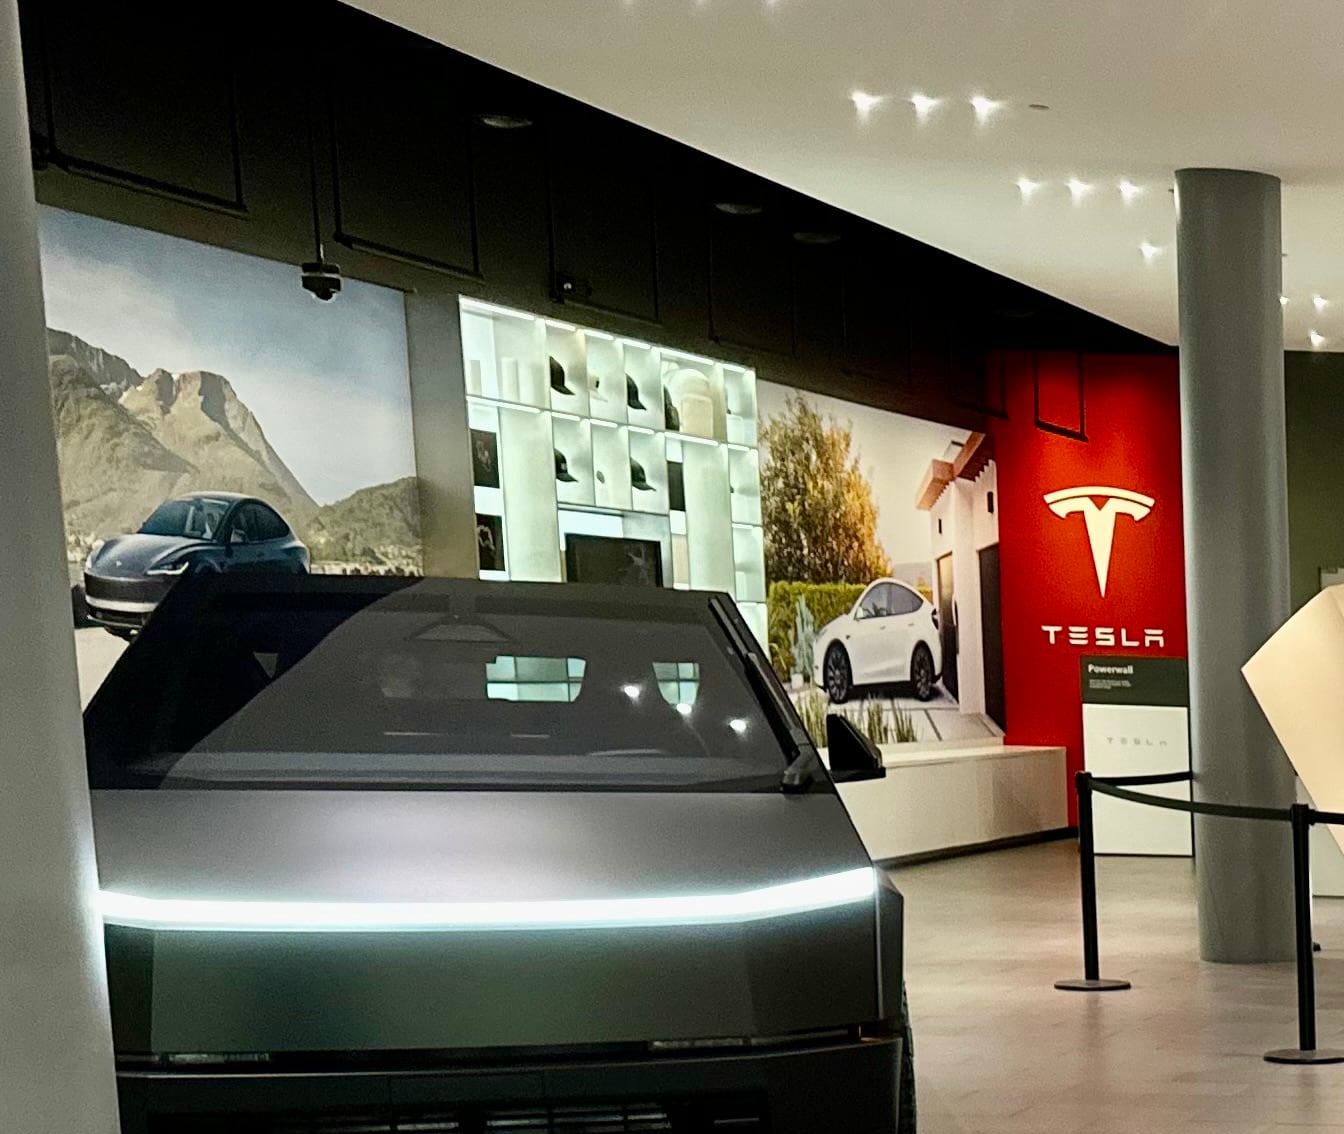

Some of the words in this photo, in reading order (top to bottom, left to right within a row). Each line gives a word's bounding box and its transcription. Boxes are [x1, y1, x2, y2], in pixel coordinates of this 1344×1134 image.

[1041, 625, 1164, 648] TESLA
[1087, 663, 1135, 675] Powerwall
[1106, 736, 1168, 747] TESLA
